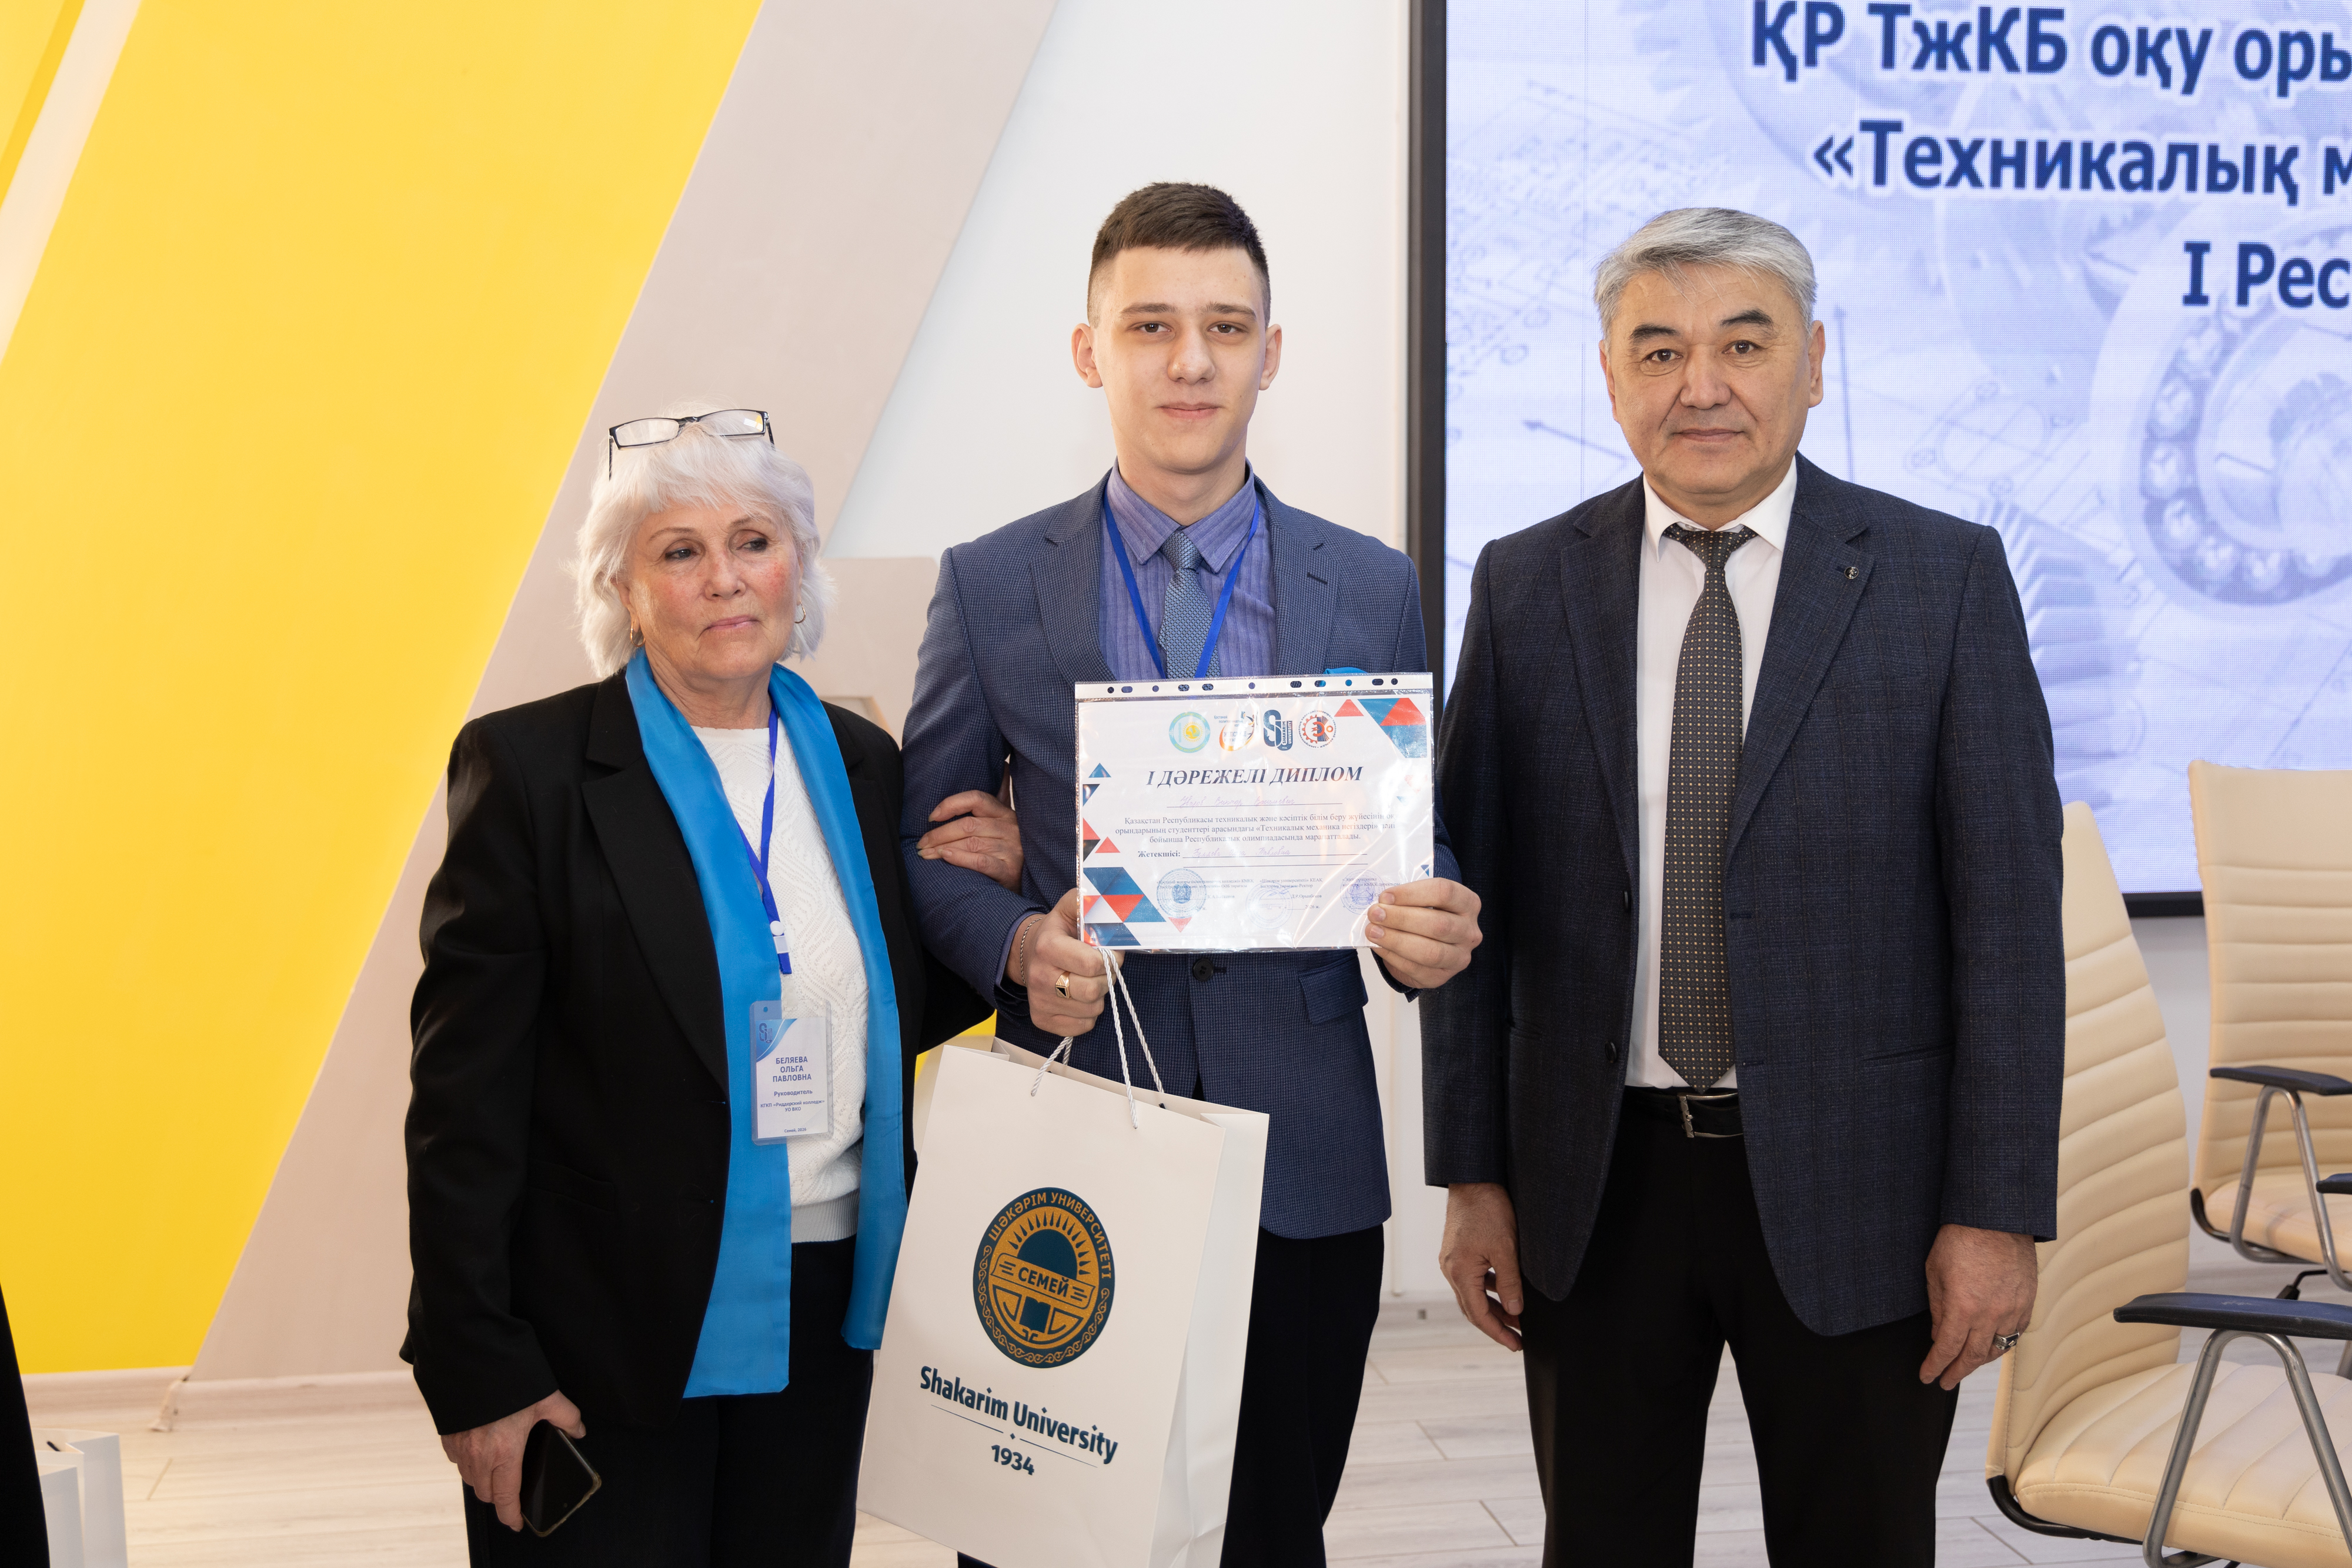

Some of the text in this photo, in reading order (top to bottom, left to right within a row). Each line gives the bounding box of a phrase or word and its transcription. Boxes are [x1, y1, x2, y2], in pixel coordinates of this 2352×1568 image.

[1753, 1, 1845, 81] ҚР
[1867, 4, 2067, 74] ТжКБ
[2090, 26, 2213, 95] оқу
[1813, 120, 2298, 206] «Техникалық
[2237, 242, 2351, 309] Рес
[1157, 768, 1267, 788] ДӘРЕЖЕЛІ
[1269, 766, 1364, 786] ДИПЛОМ
[1162, 816, 1213, 825] Республикасы
[1330, 814, 1345, 822] беру
[1348, 813, 1385, 821] жүйесінің
[1168, 826, 1210, 834] студенттері
[1305, 833, 1361, 841] марапатталады.
[776, 1056, 808, 1064] БЕЛЯЕВА
[773, 1074, 811, 1082] ПАВЛОВНА
[988, 1192, 1111, 1279] ШӘКӘРІМ УНИВЕРСИТЕТІ
[1018, 1266, 1069, 1297] СЕМЕЙ
[920, 1365, 1118, 1465] Shakarim University
[991, 1445, 1034, 1476] 1934
